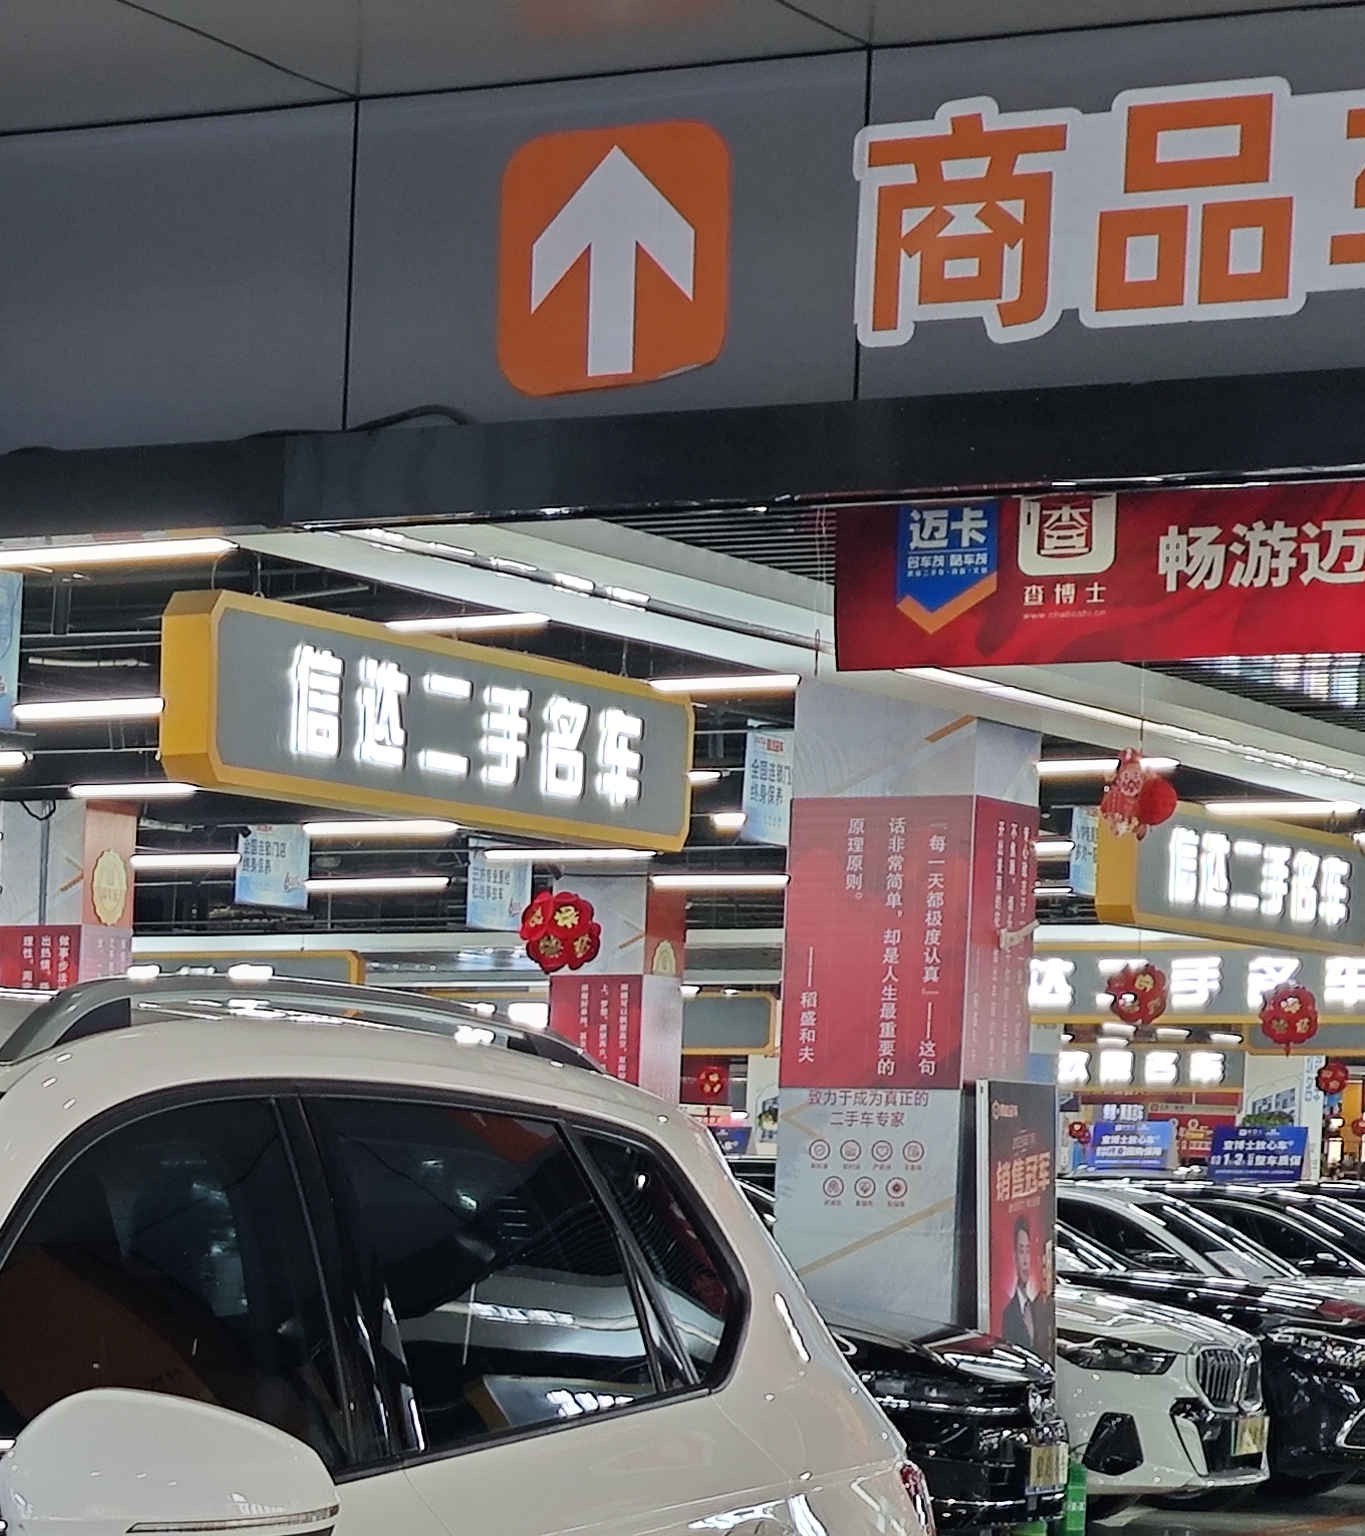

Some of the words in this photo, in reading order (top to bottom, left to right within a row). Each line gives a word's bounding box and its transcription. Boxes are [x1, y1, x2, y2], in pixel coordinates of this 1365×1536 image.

[867, 92, 1365, 332] 商品
[909, 508, 988, 549] 迈卡
[1158, 518, 1365, 592] 畅游迈
[1023, 583, 1107, 606] 查博士
[289, 645, 643, 808] 信达二手名车
[845, 817, 866, 899] 原理原则。
[1169, 826, 1352, 927] 信达二手名车
[877, 816, 906, 1076] 话非常简单，却是人生最重要的
[808, 1089, 929, 1108] 致力于成为真正的
[830, 1111, 906, 1127] 二手车专家
[996, 1151, 1051, 1202] 销售冠军
